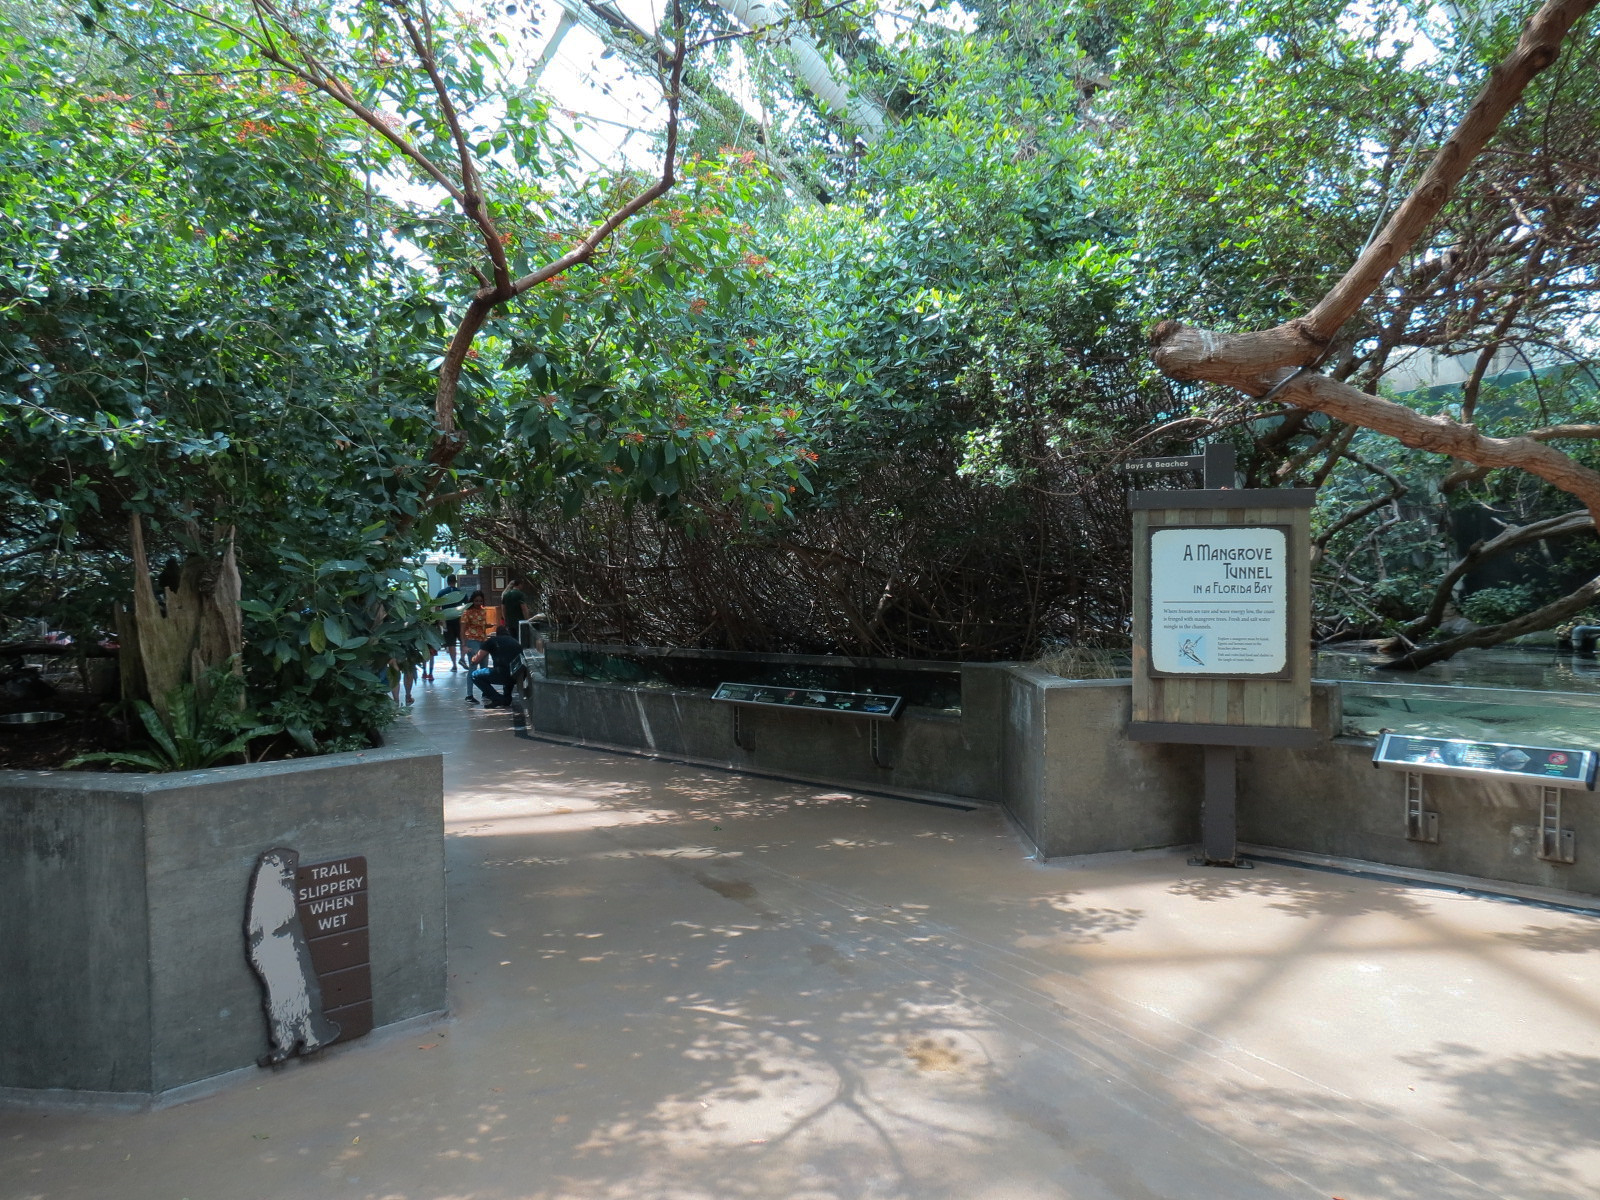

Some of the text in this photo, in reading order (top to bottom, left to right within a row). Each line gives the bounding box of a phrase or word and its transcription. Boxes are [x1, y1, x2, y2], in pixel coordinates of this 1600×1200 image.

[1125, 460, 1189, 471] Bays & Beaches
[1183, 544, 1273, 561] A MANGROVE
[1223, 563, 1273, 579] TUNNEL
[1193, 582, 1273, 594] IN A FLORIDA BAY
[311, 863, 351, 880] TRAIL
[299, 876, 363, 900] SLIPPERY
[310, 896, 354, 915] WHEN
[318, 913, 348, 930] WET
